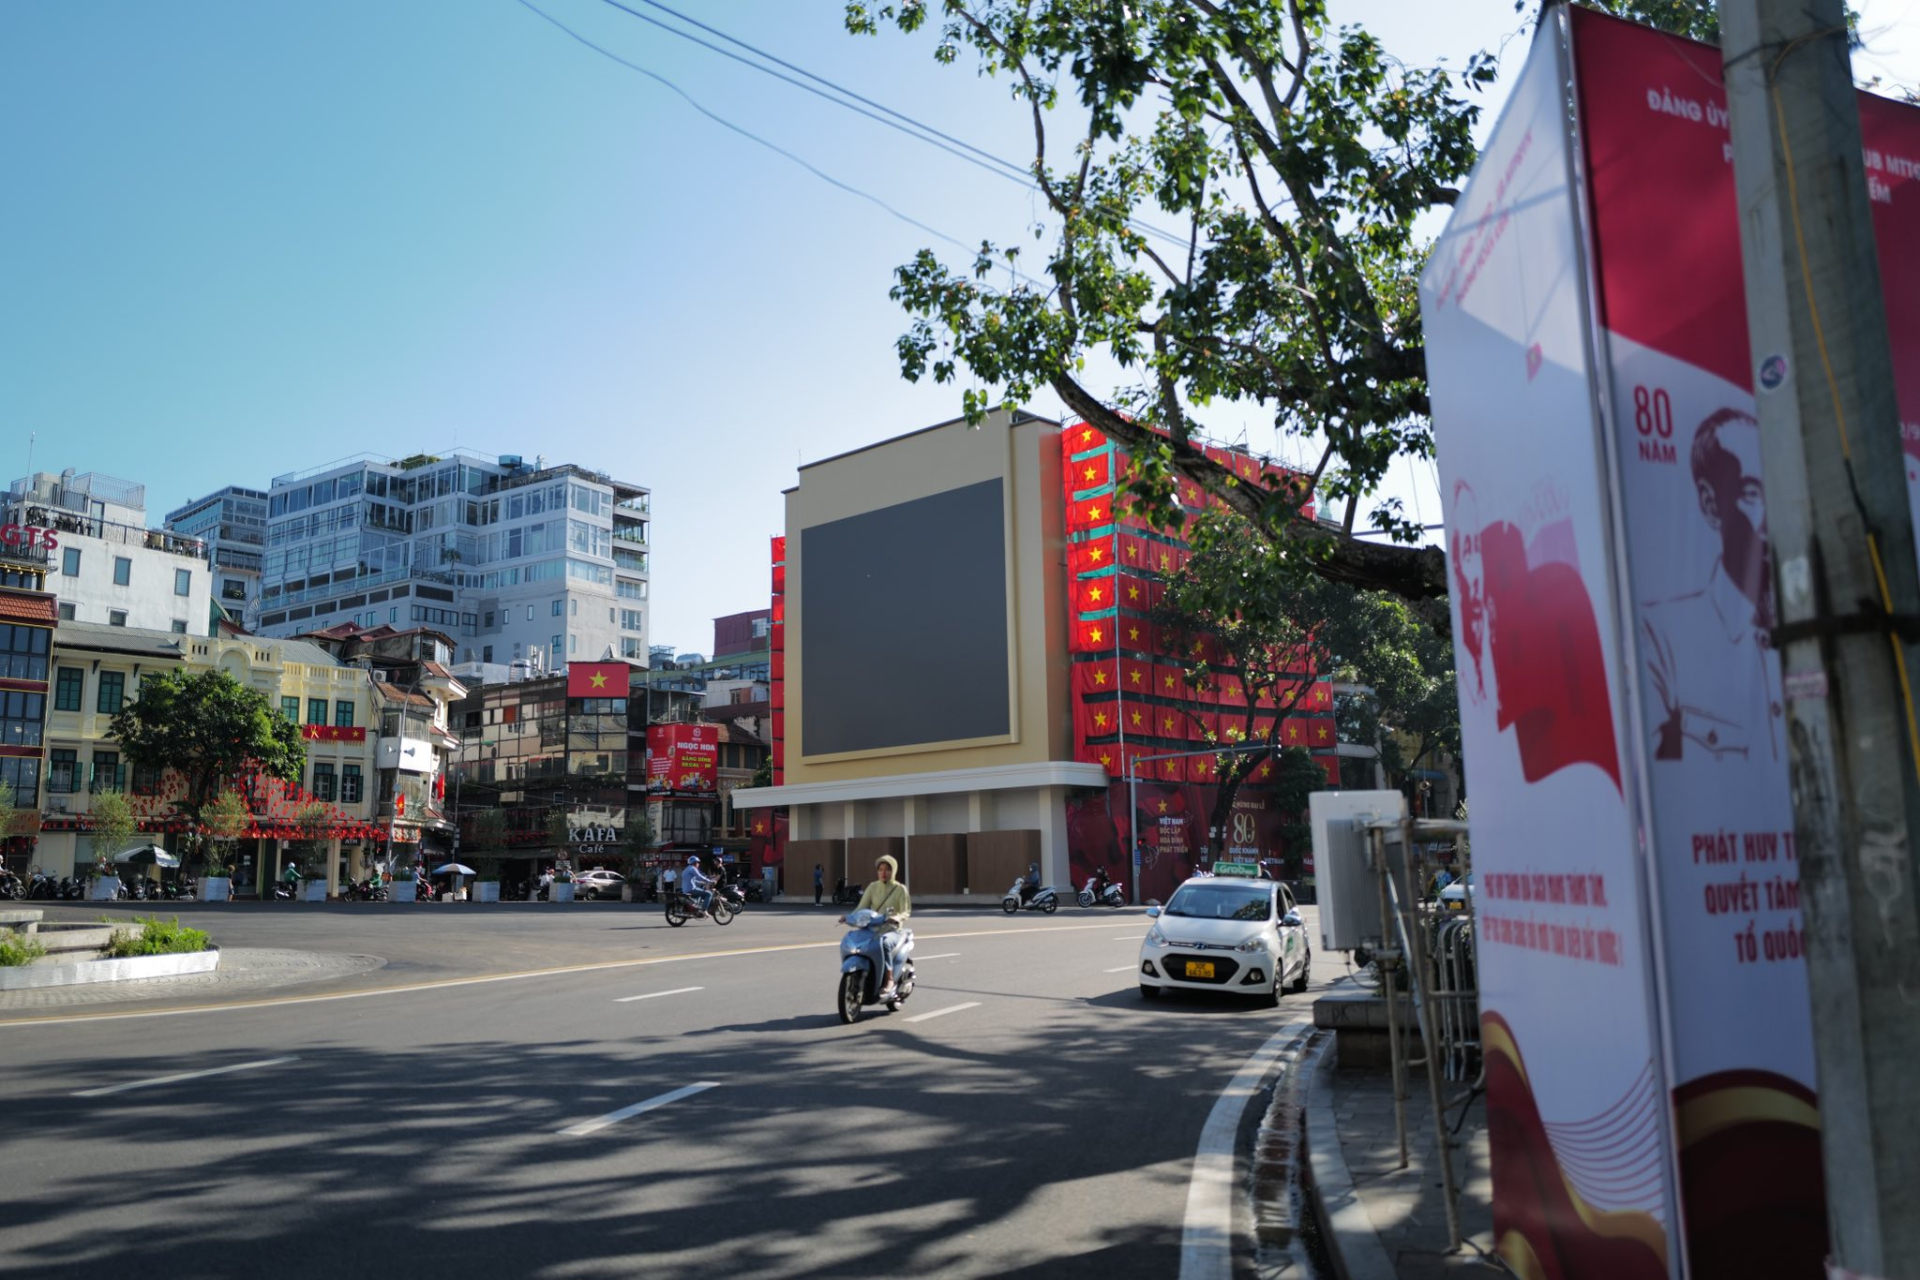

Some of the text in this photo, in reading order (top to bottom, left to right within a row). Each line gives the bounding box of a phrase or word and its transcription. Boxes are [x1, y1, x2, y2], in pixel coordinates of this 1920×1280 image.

[1647, 86, 1702, 122] ĐẢNG
[1634, 385, 1673, 439] 80
[1638, 439, 1677, 465] NĂM
[677, 742, 716, 752] NGỌC HOA
[569, 827, 617, 842] KAFA
[1233, 812, 1255, 844] 80
[579, 843, 605, 854] Café
[1692, 828, 1737, 864] PHÁT
[1743, 832, 1777, 862] HUY
[1705, 872, 1758, 914] QUYẾT
